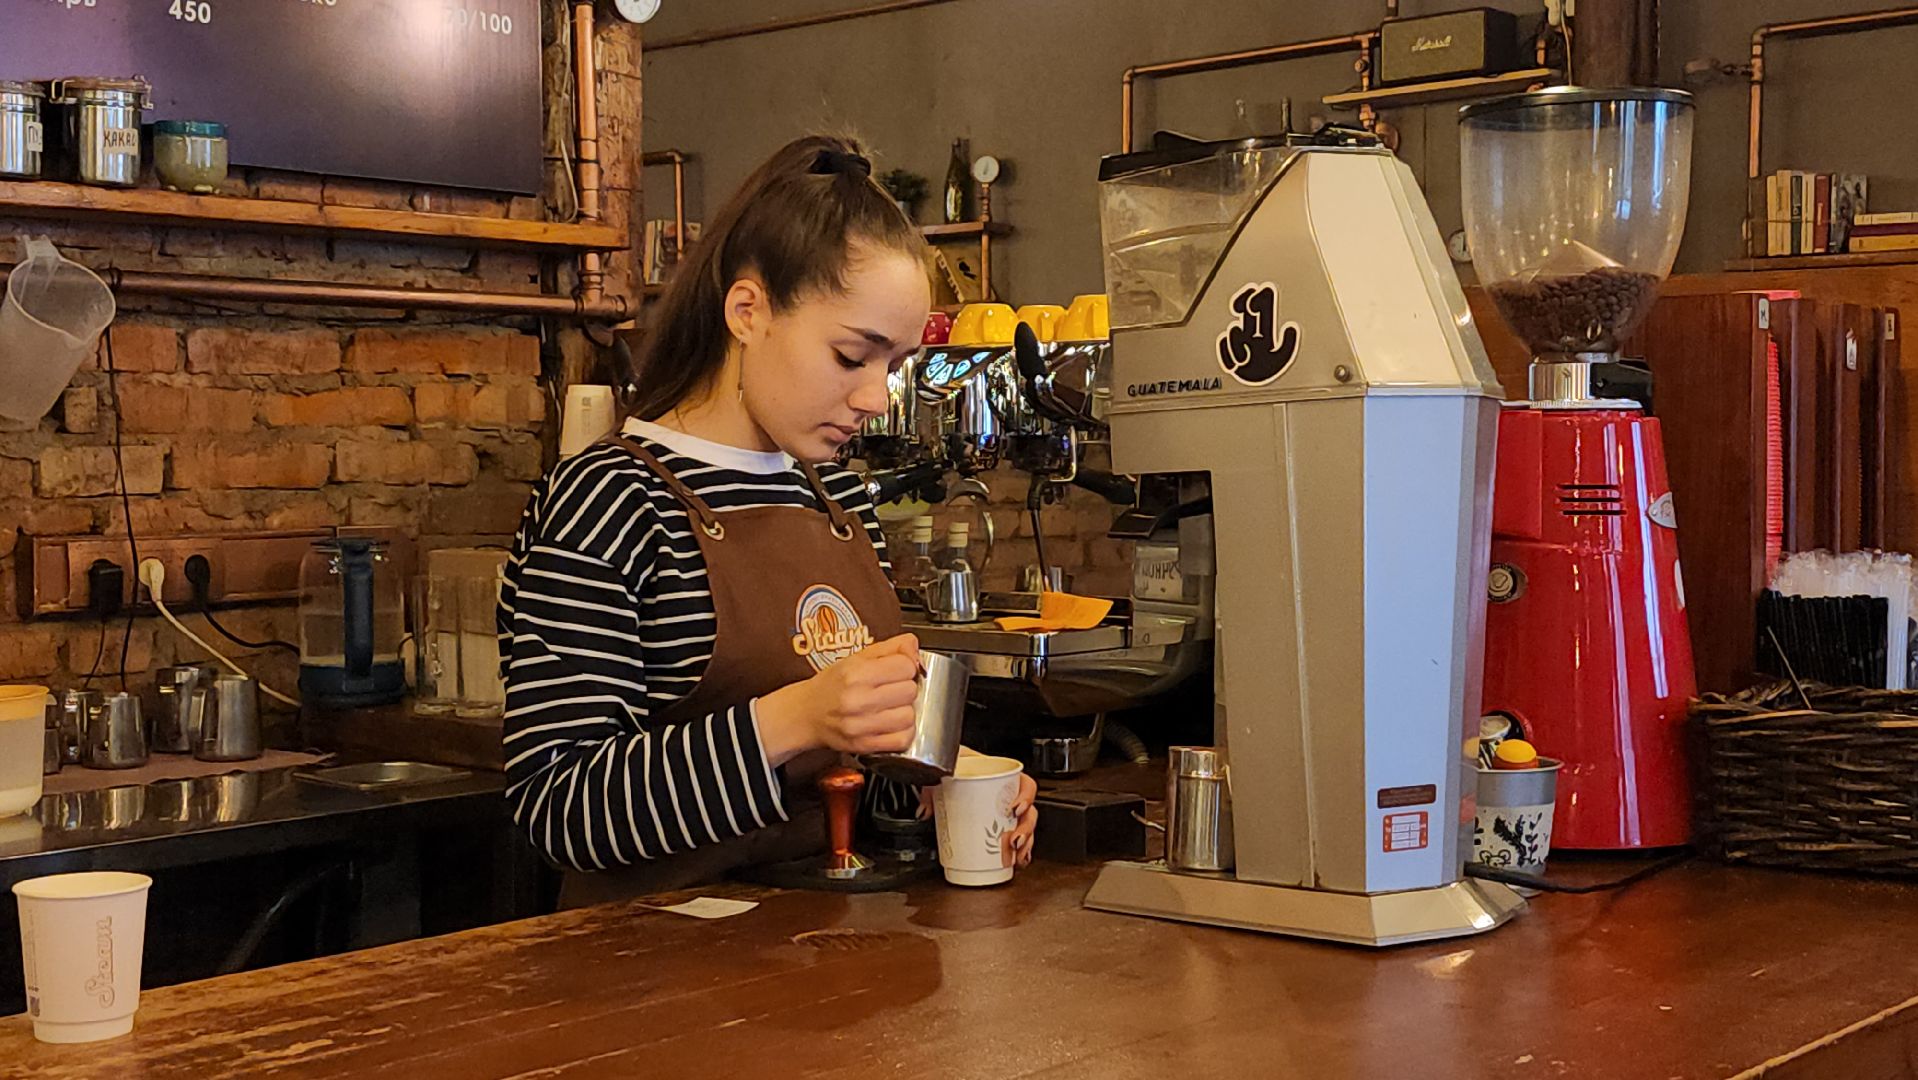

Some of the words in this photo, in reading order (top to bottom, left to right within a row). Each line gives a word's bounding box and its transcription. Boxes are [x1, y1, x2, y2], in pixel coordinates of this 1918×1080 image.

[168, 0, 211, 24] 450
[1127, 376, 1223, 398] GUATEMALA
[792, 617, 875, 656] Steam
